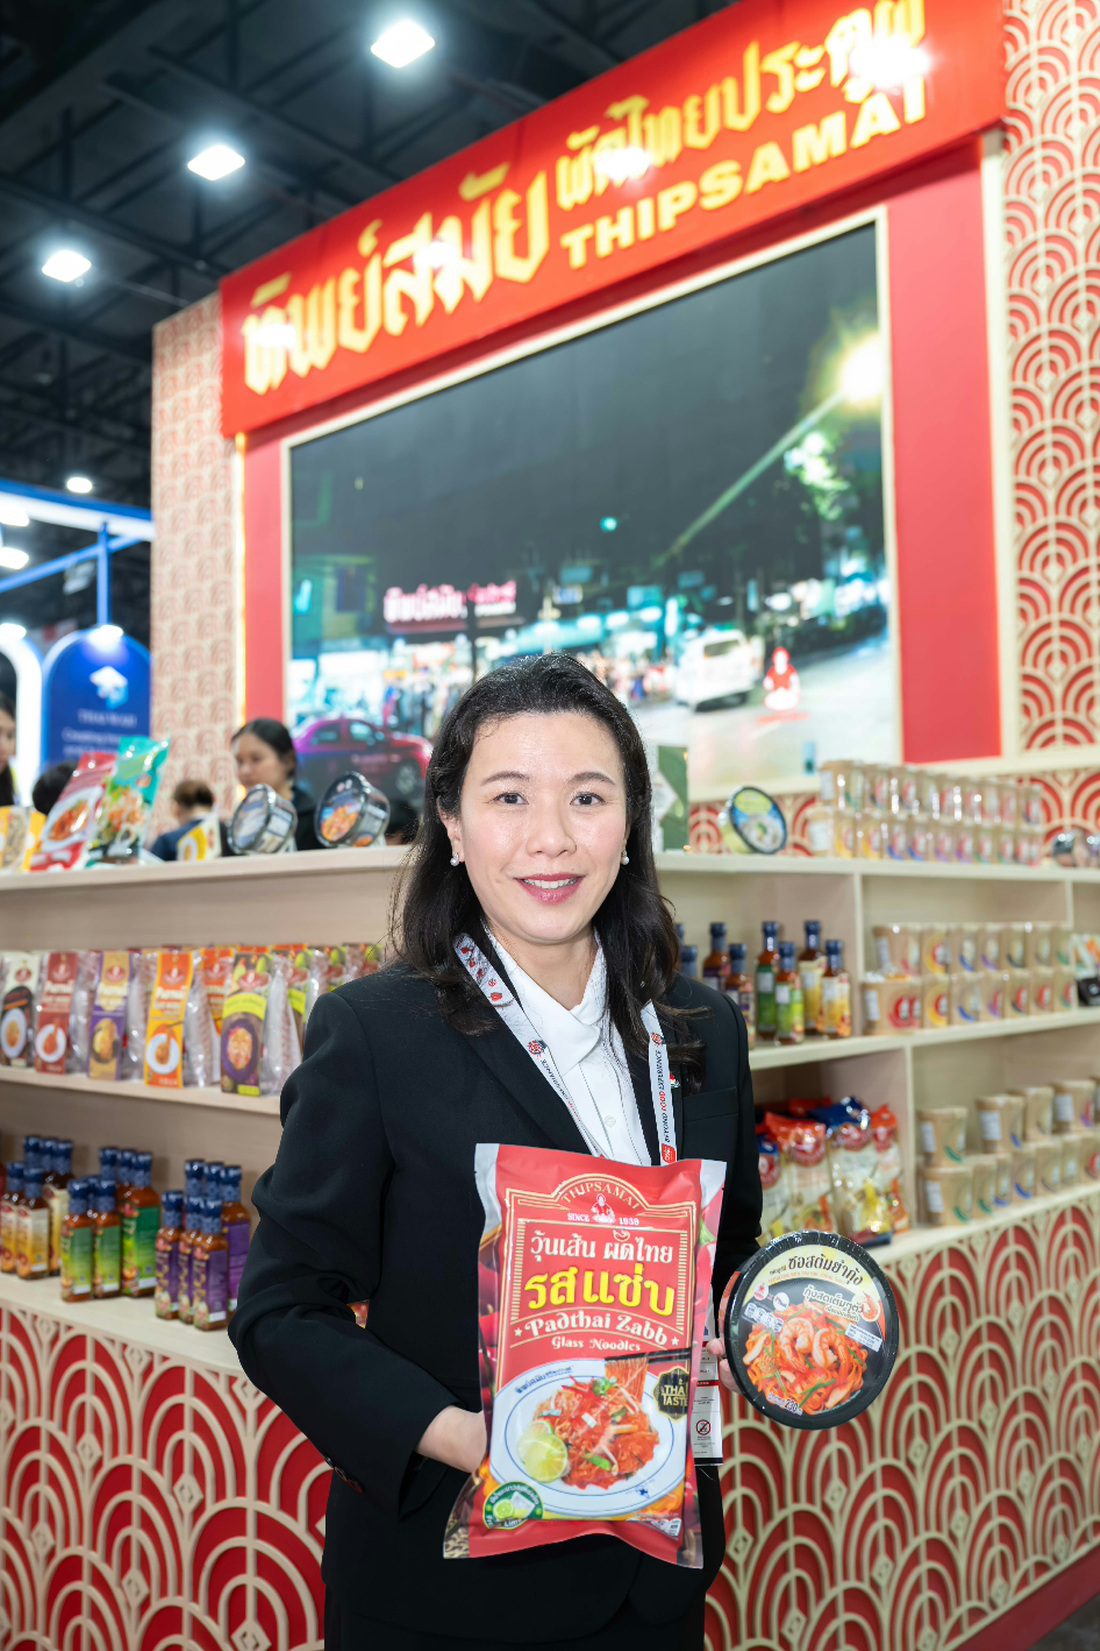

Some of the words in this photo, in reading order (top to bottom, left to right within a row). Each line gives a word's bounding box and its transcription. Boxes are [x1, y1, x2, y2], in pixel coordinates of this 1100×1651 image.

[560, 76, 925, 270] THIPSAMAI
[241, 161, 550, 396] ทิพย์สมัย
[567, 1212, 590, 1223] SINCE
[531, 1230, 596, 1263] วุ้นเส้น
[603, 1229, 673, 1264] ผัดไทย
[524, 1263, 675, 1317] รสแซ่บ
[525, 1310, 611, 1338] Padthai
[616, 1315, 668, 1346] Zabb
[551, 1336, 584, 1349] Glass
[589, 1337, 641, 1351] Noodles
